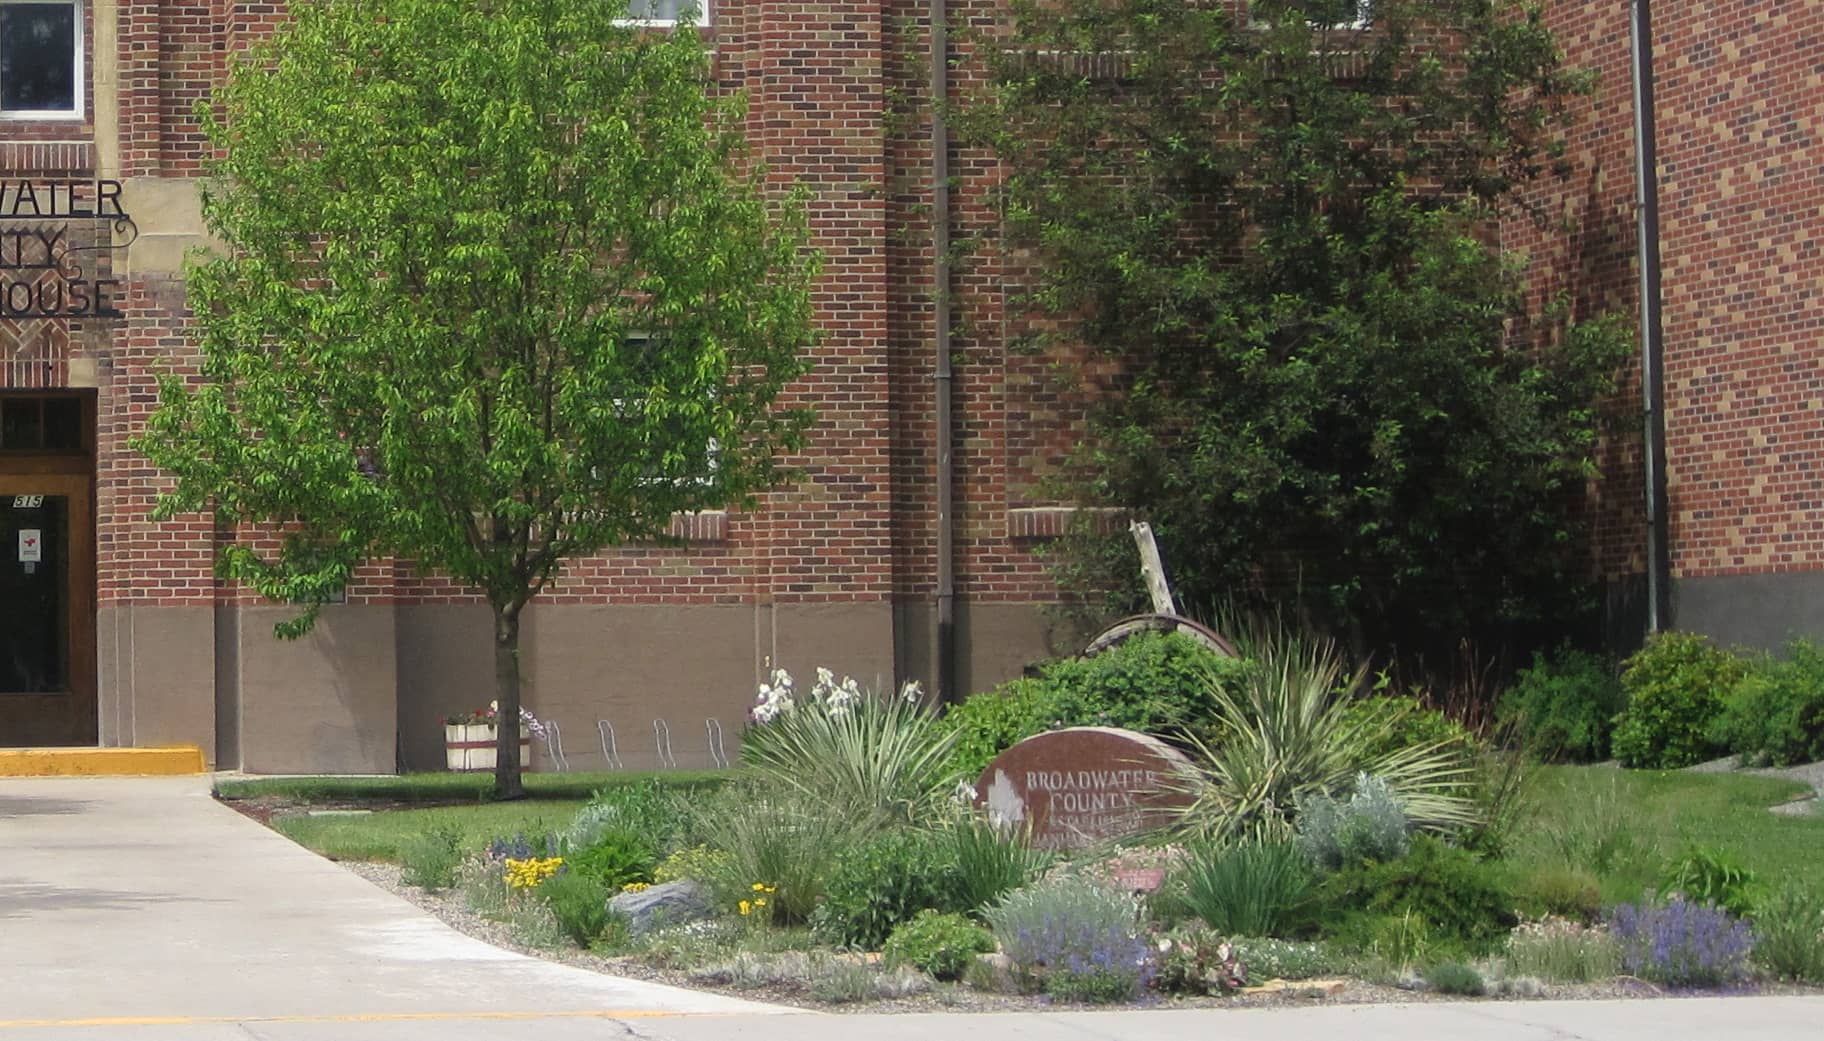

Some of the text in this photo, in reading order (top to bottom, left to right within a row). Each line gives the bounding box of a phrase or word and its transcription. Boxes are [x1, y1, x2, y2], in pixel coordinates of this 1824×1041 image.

[15, 495, 42, 507] 515
[1026, 769, 1155, 791] BROADWATER
[1050, 792, 1133, 813] COUNTY
